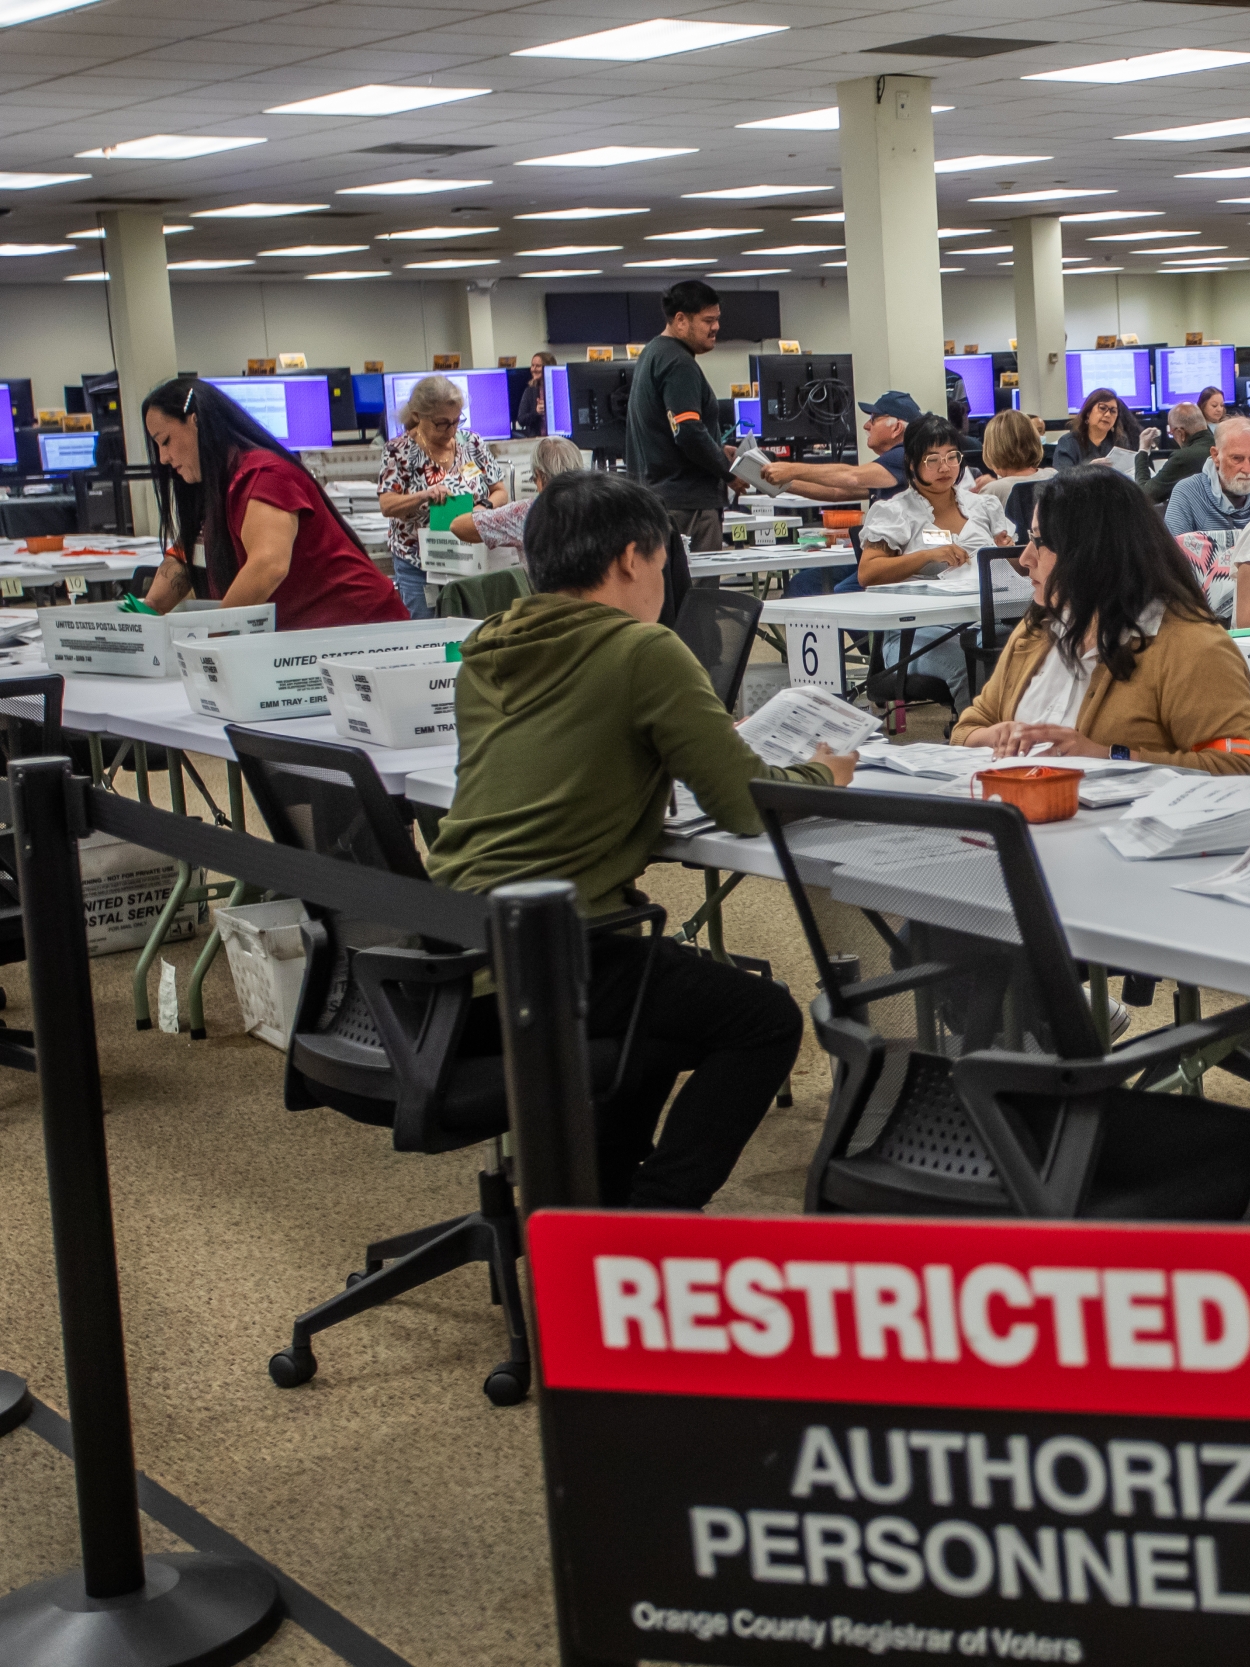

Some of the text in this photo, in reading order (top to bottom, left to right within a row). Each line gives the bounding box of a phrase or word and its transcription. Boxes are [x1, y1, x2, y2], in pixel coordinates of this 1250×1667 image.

[733, 525, 746, 539] 69
[774, 522, 787, 536] 68
[69, 577, 82, 590] 10
[55, 620, 143, 633] UNITED STATES POSTAL SERVICE
[200, 656, 216, 665] LABEL
[802, 631, 818, 677] 6
[273, 654, 318, 668] UNITED
[202, 665, 218, 674] OTHER
[352, 674, 369, 684] LABEL
[429, 677, 457, 690] UNIT
[355, 683, 372, 693] OTHER
[260, 700, 280, 709] EMM
[281, 697, 303, 706] TRAY
[414, 726, 435, 735] EMM
[136, 867, 161, 877] PRIVATE
[162, 865, 175, 873] USE
[84, 887, 175, 912] NITED STATE
[85, 911, 124, 928] STAL
[631, 1600, 1084, 1665] Orange County Registrar of Voters
